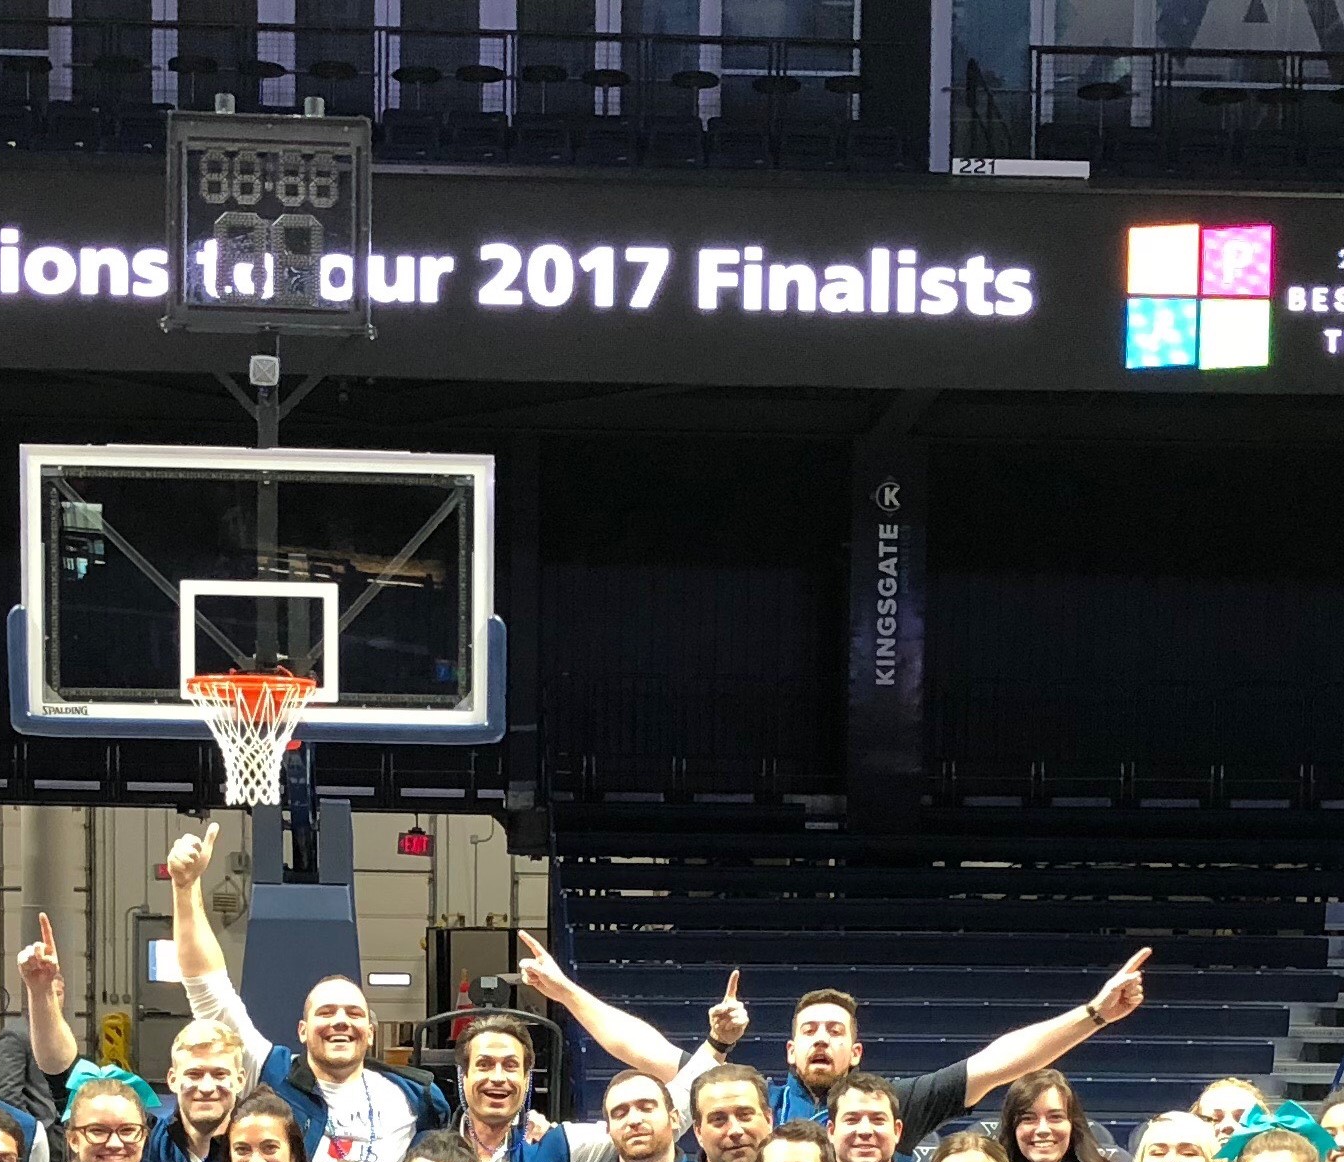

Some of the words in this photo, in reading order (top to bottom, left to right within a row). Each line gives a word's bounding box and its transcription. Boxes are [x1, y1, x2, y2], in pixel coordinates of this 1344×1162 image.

[959, 159, 995, 174] 221
[320, 252, 455, 304] our
[478, 243, 670, 308] 2017
[697, 247, 1034, 316] Finalists
[875, 523, 899, 686] KINGSGATE
[42, 705, 89, 716] SPALDING
